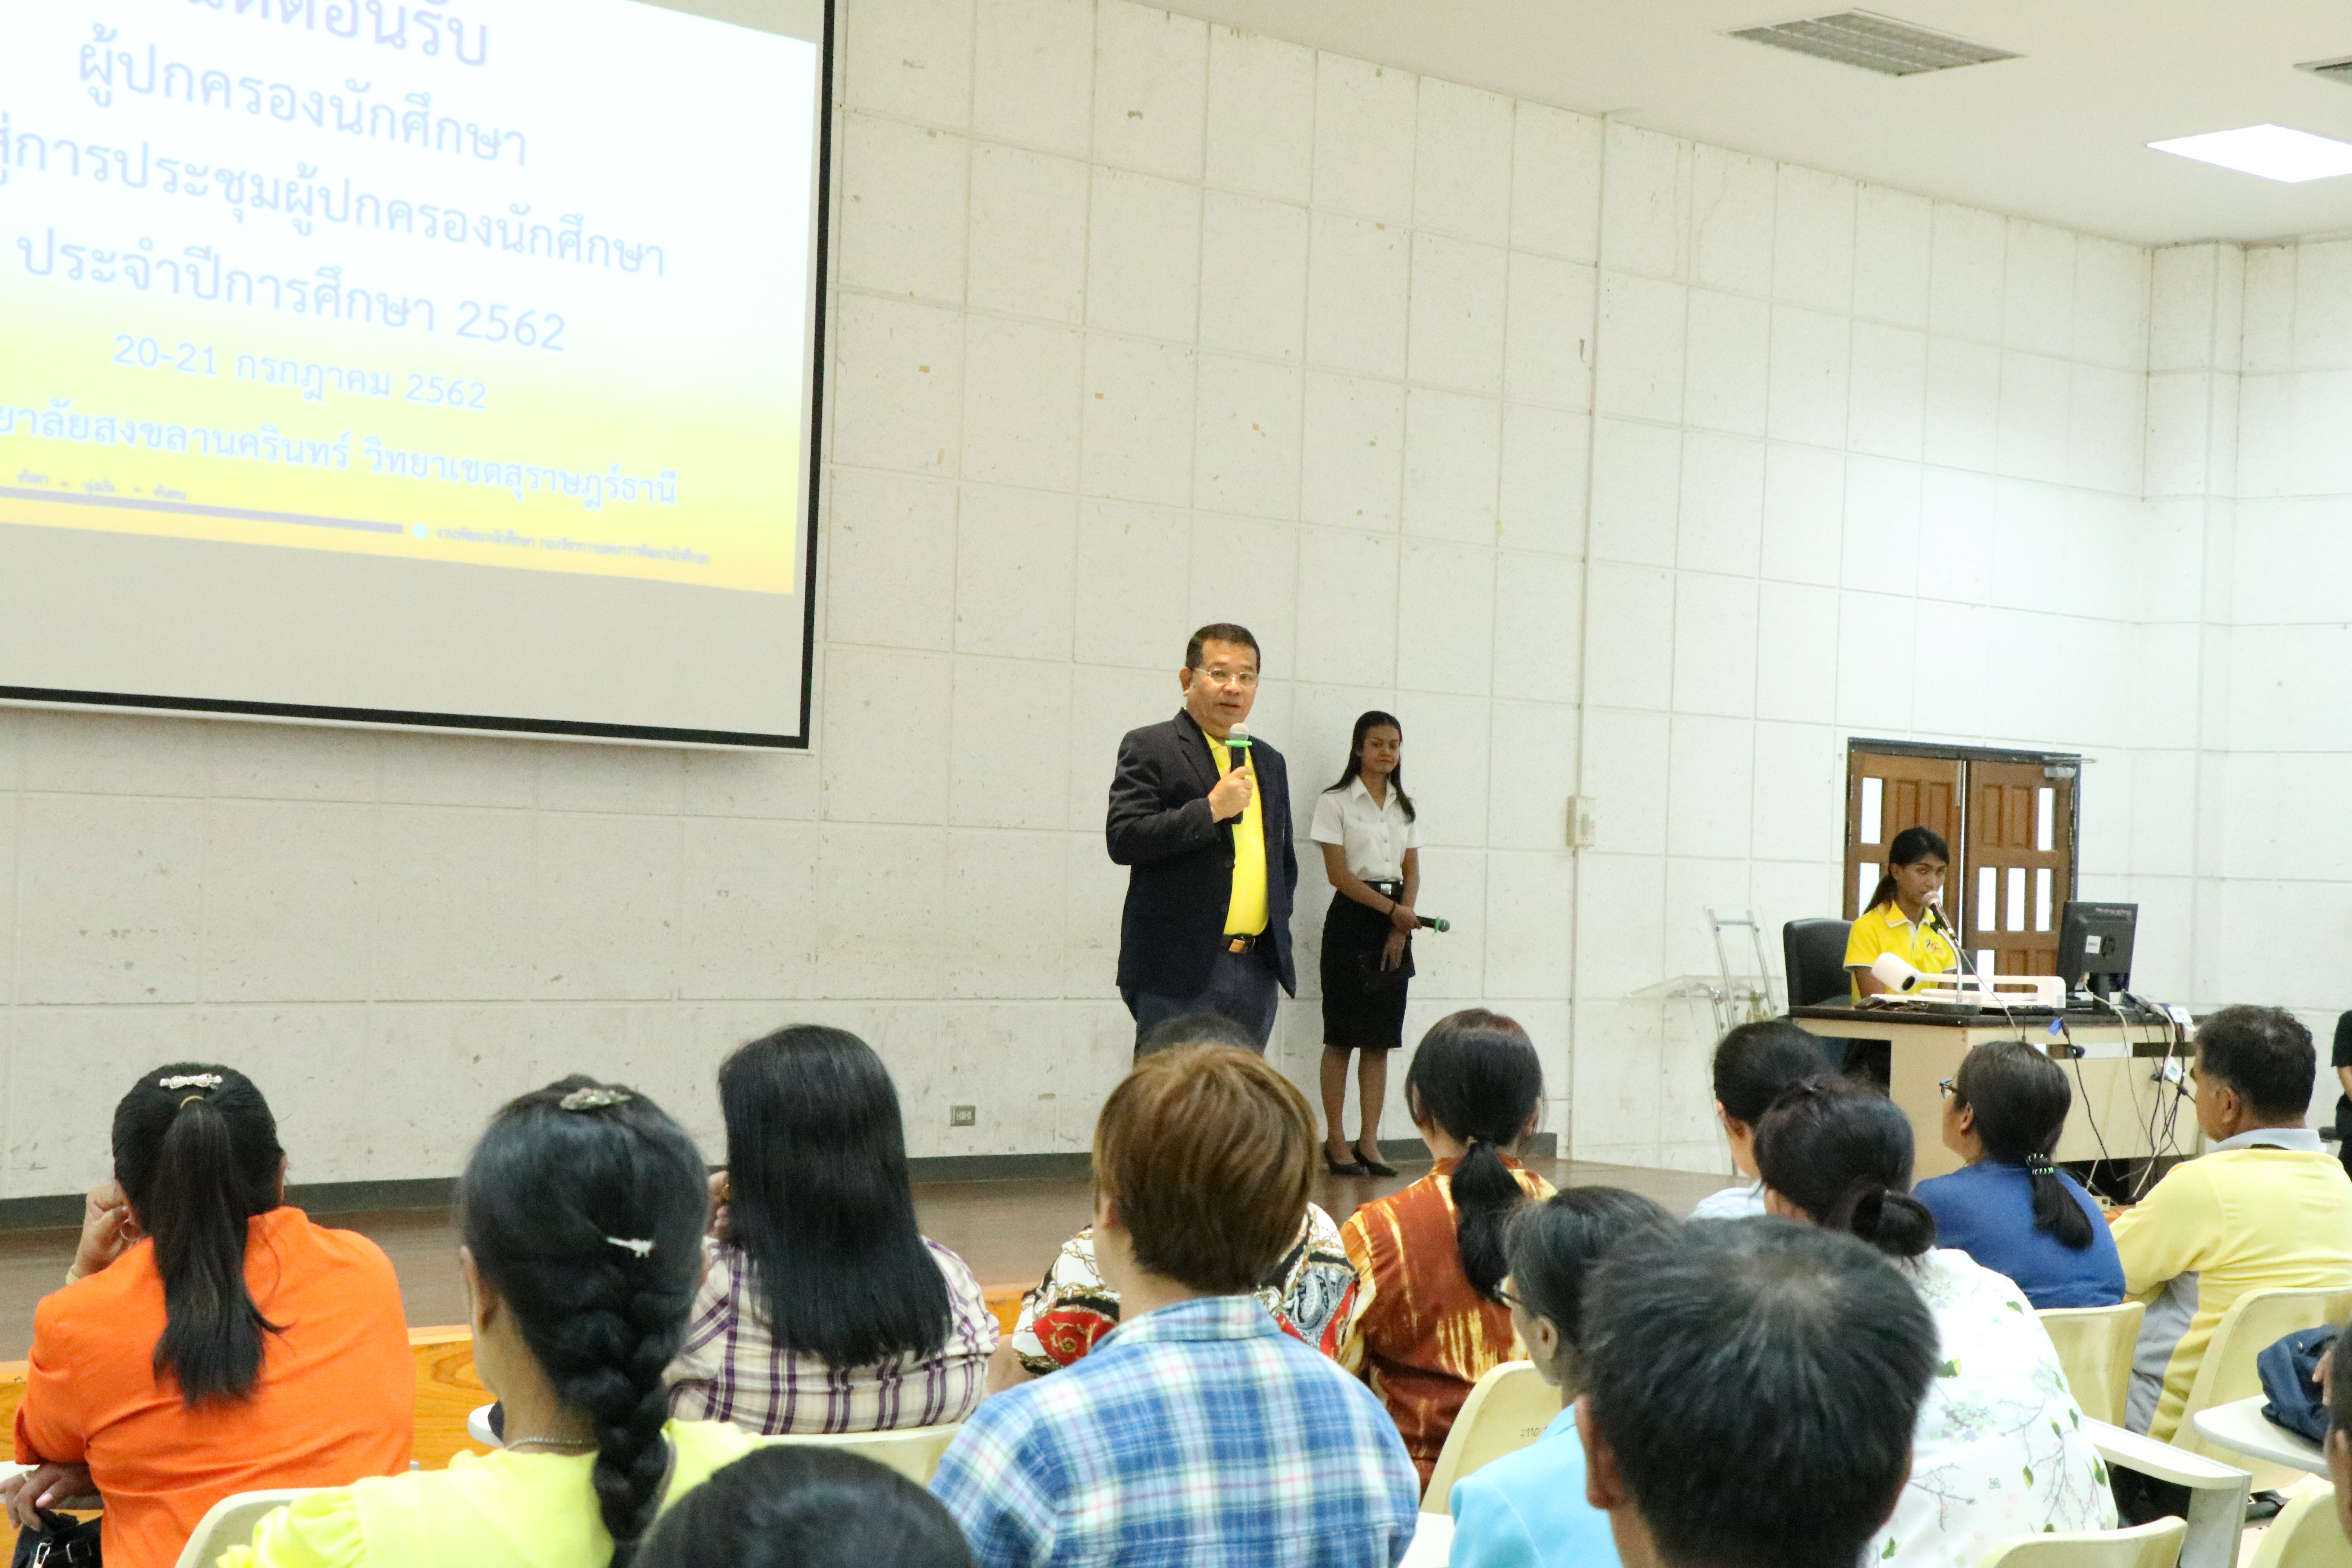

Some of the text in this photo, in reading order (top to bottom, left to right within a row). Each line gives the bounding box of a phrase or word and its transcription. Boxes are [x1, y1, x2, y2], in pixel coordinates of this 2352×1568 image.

[79, 22, 526, 167] ผู้ปกครองนักศึกษา
[16, 227, 565, 351] ประจำปีการศึกษา 2562
[114, 334, 486, 409] 20-21 กรกฎาคม 2562
[365, 436, 676, 509] วิทยาเขตสุราษฎร์ธานี
